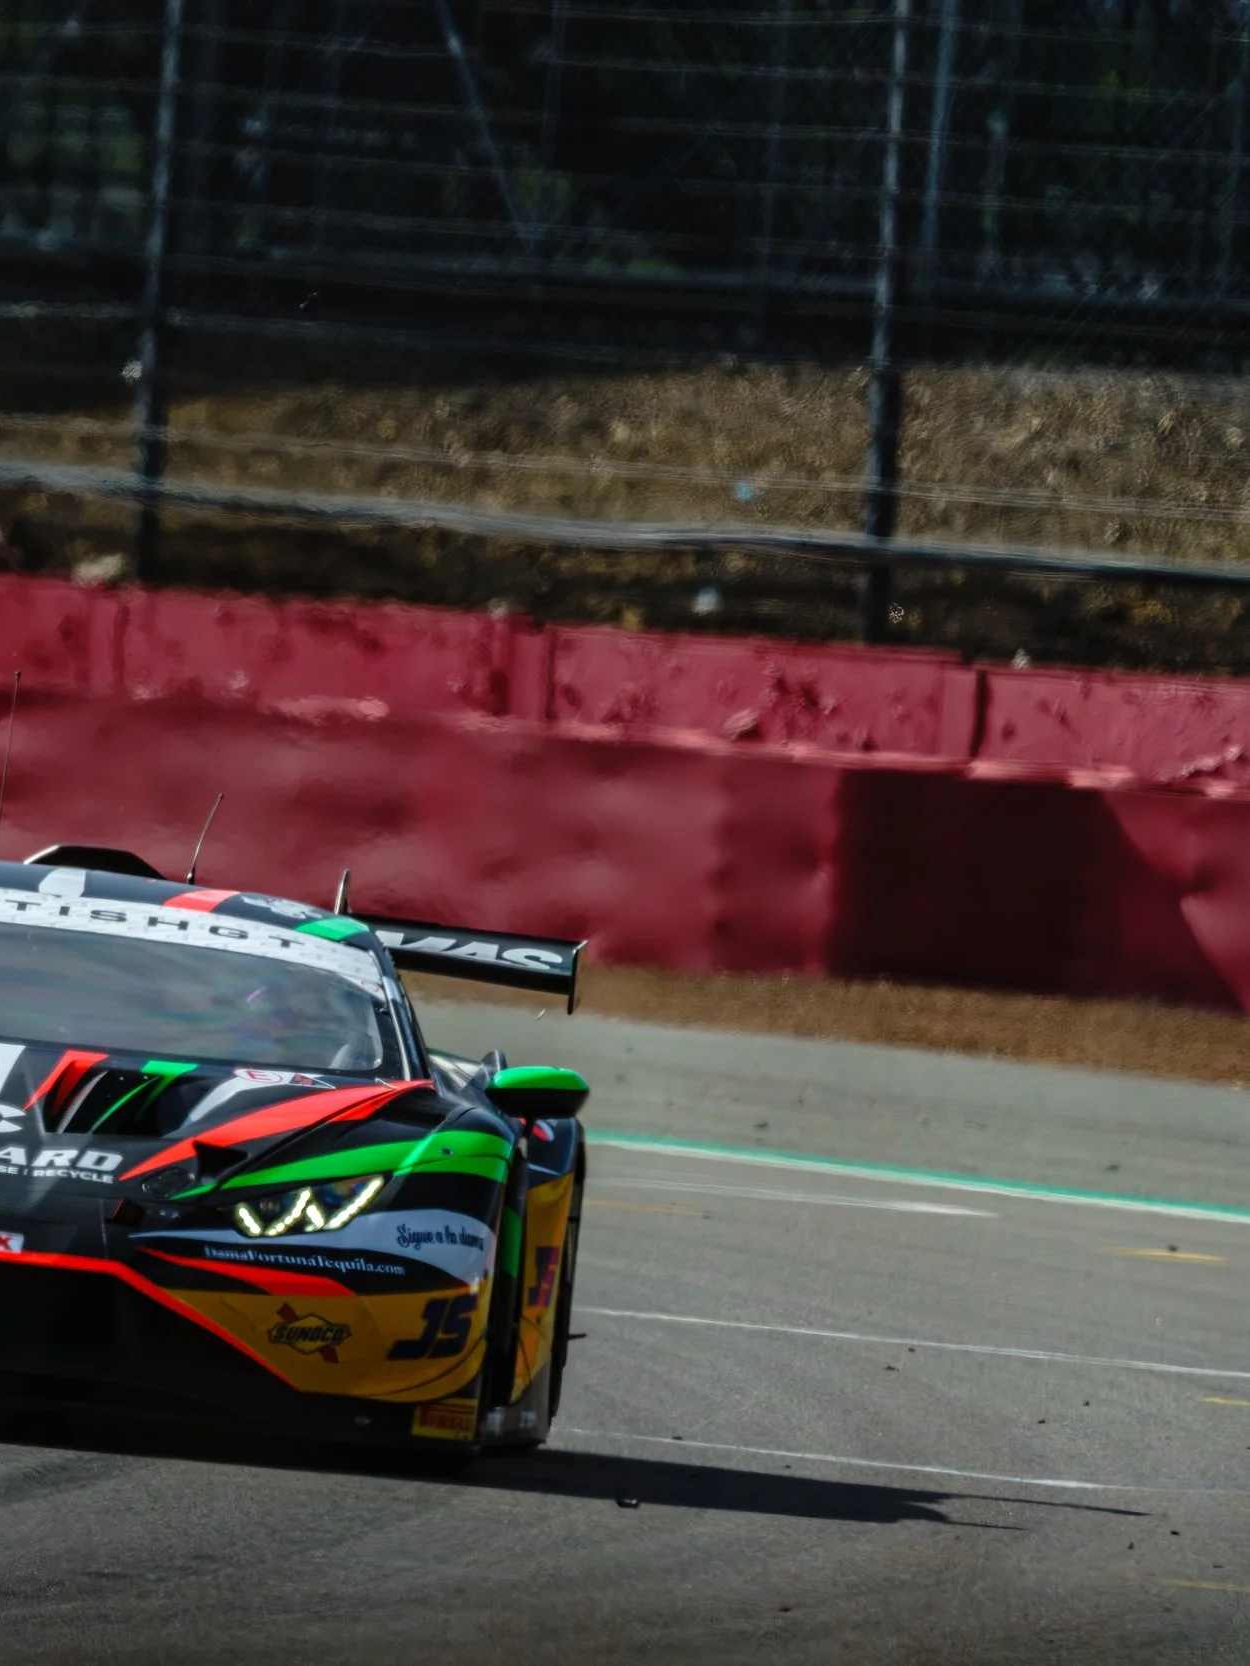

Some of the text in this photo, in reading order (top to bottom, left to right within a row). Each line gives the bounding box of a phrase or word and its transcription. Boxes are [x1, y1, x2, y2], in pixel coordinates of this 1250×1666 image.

[33, 1168, 114, 1185] RECYCLE
[273, 1323, 347, 1345] SUNOCO
[386, 1294, 478, 1359] JS
